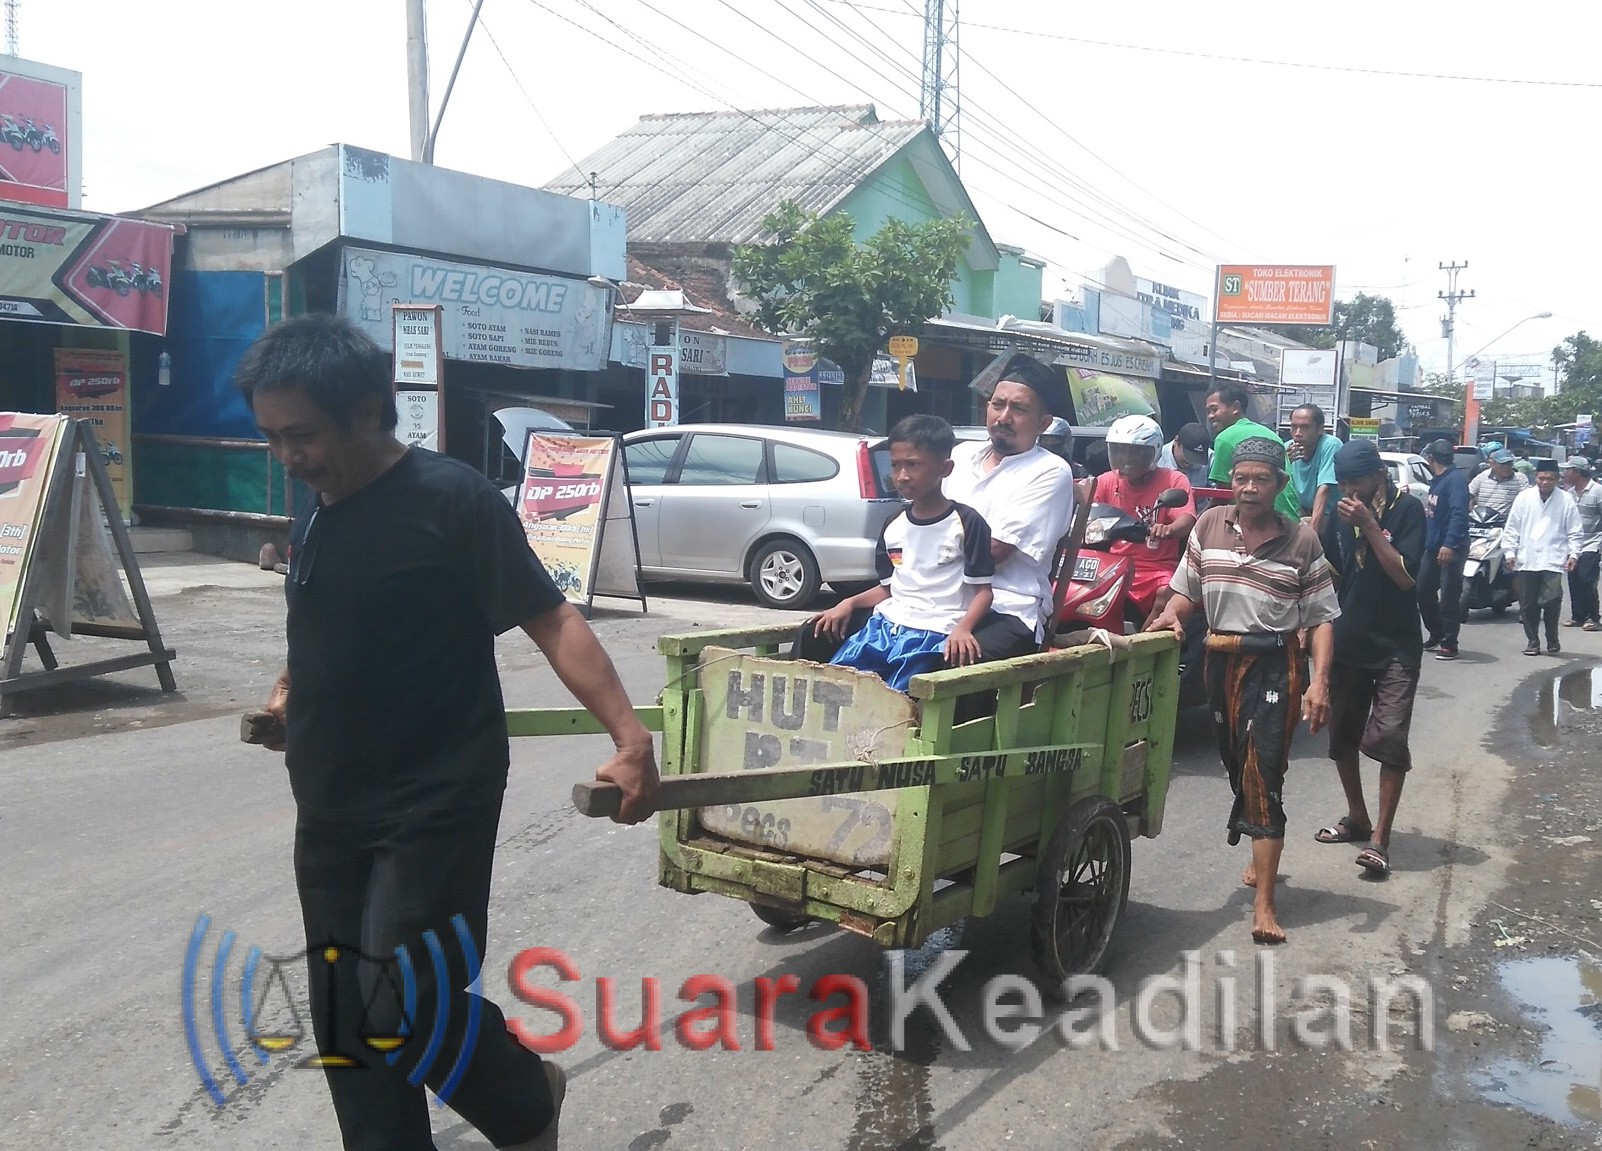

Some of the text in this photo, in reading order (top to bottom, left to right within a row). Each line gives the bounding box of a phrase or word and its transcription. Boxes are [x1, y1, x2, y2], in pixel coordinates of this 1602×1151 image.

[1253, 269, 1323, 278] TOKO ELEKTRONIK
[411, 264, 567, 313] WELCOME
[1225, 277, 1241, 293] ST
[461, 305, 480, 317] Food
[403, 311, 428, 321] PAWON
[468, 323, 506, 332] SOTO AYAM
[524, 328, 539, 336] NASI
[468, 333, 504, 342] SOTO SAPI
[488, 345, 517, 353] GORENG
[538, 348, 563, 357] GORENG
[681, 348, 703, 363] SARI
[407, 395, 427, 403] SOTO
[407, 431, 427, 439] AYAM
[526, 482, 601, 500] DP 250rb
[726, 670, 854, 731] HUT
[808, 747, 1083, 796] SATU NUSA SATU BANGSA
